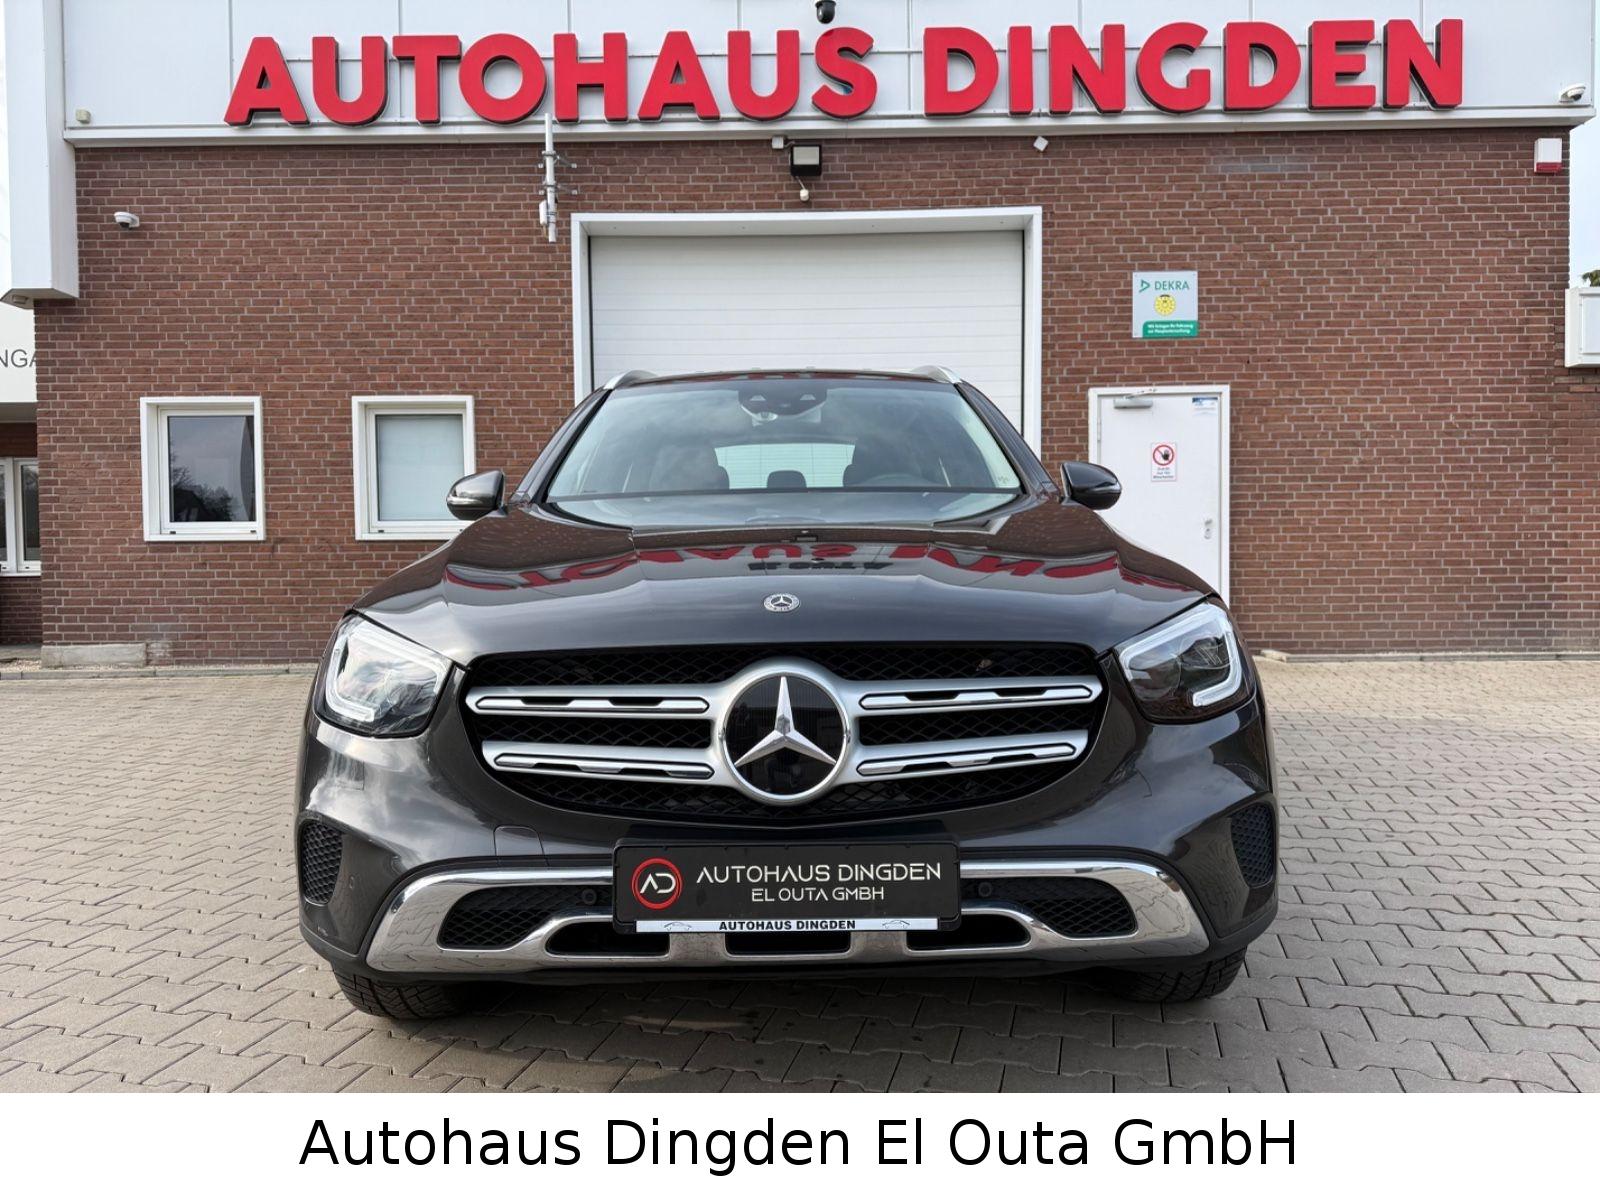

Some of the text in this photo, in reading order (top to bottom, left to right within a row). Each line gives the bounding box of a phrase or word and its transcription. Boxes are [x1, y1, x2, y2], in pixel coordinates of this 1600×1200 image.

[225, 19, 1463, 126] AUTOHAUS DINGDEN
[1154, 280, 1190, 290] DEKRA
[696, 862, 941, 884] AUTOHAUS DINGDEN
[751, 886, 885, 903] EL OUTA GMBH
[718, 919, 857, 931] AUTOHAUS DINGDEN
